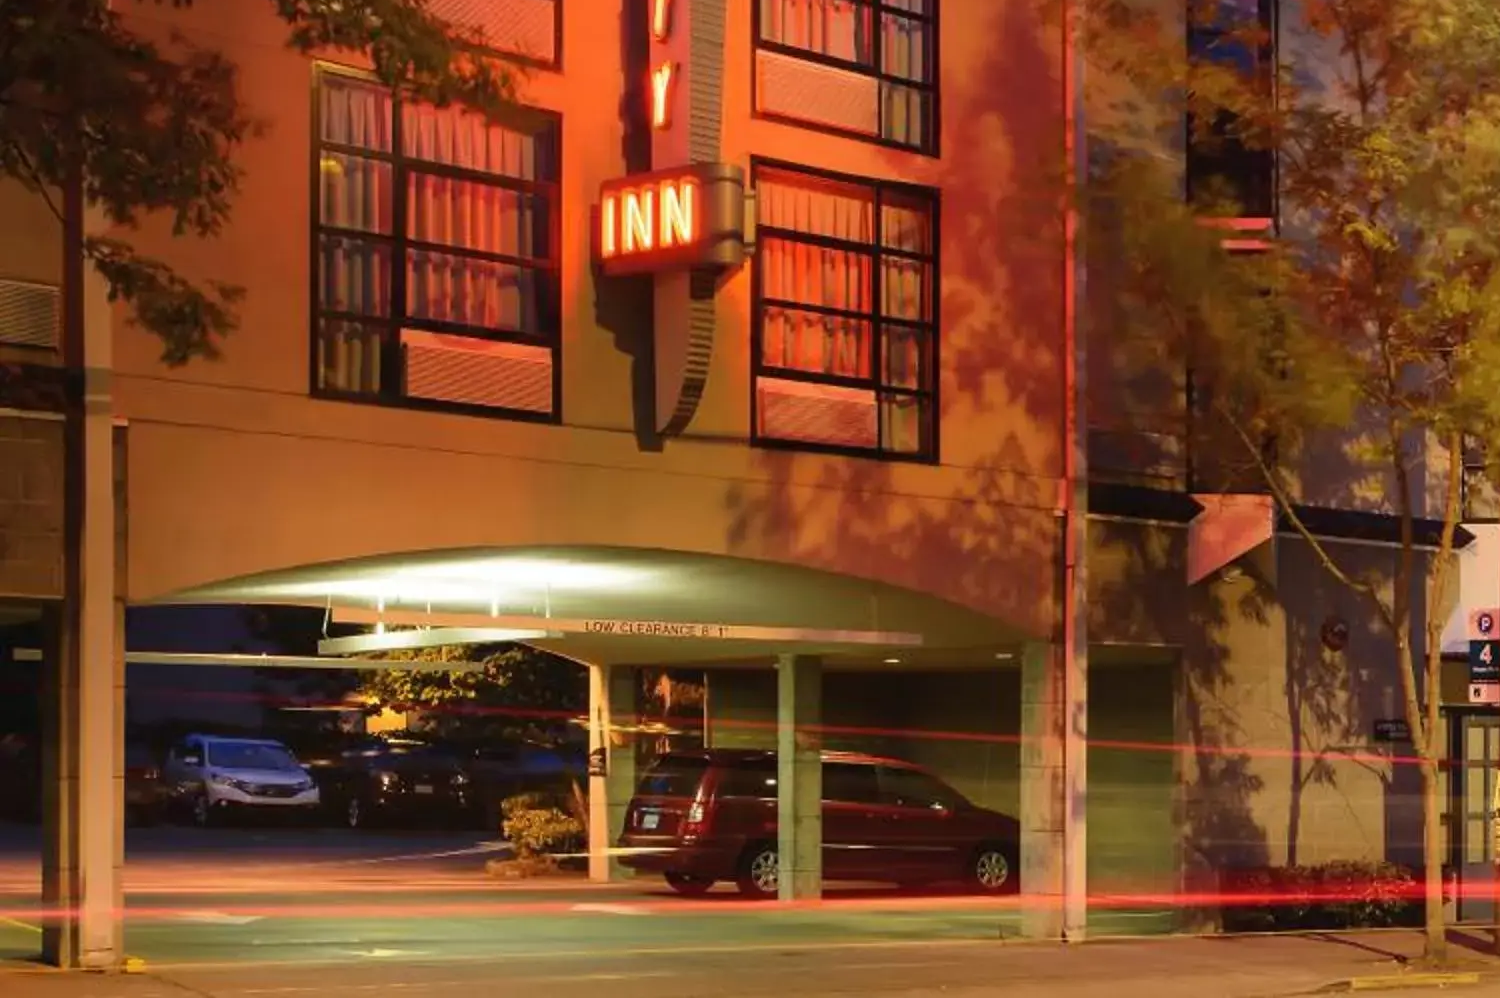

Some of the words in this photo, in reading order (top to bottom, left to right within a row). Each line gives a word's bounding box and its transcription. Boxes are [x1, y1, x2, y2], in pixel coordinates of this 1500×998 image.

[602, 178, 695, 258] INN
[585, 621, 615, 632] LOW
[619, 621, 695, 635] CLEARANCE
[1481, 617, 1491, 631] P
[1479, 643, 1493, 665] 4
